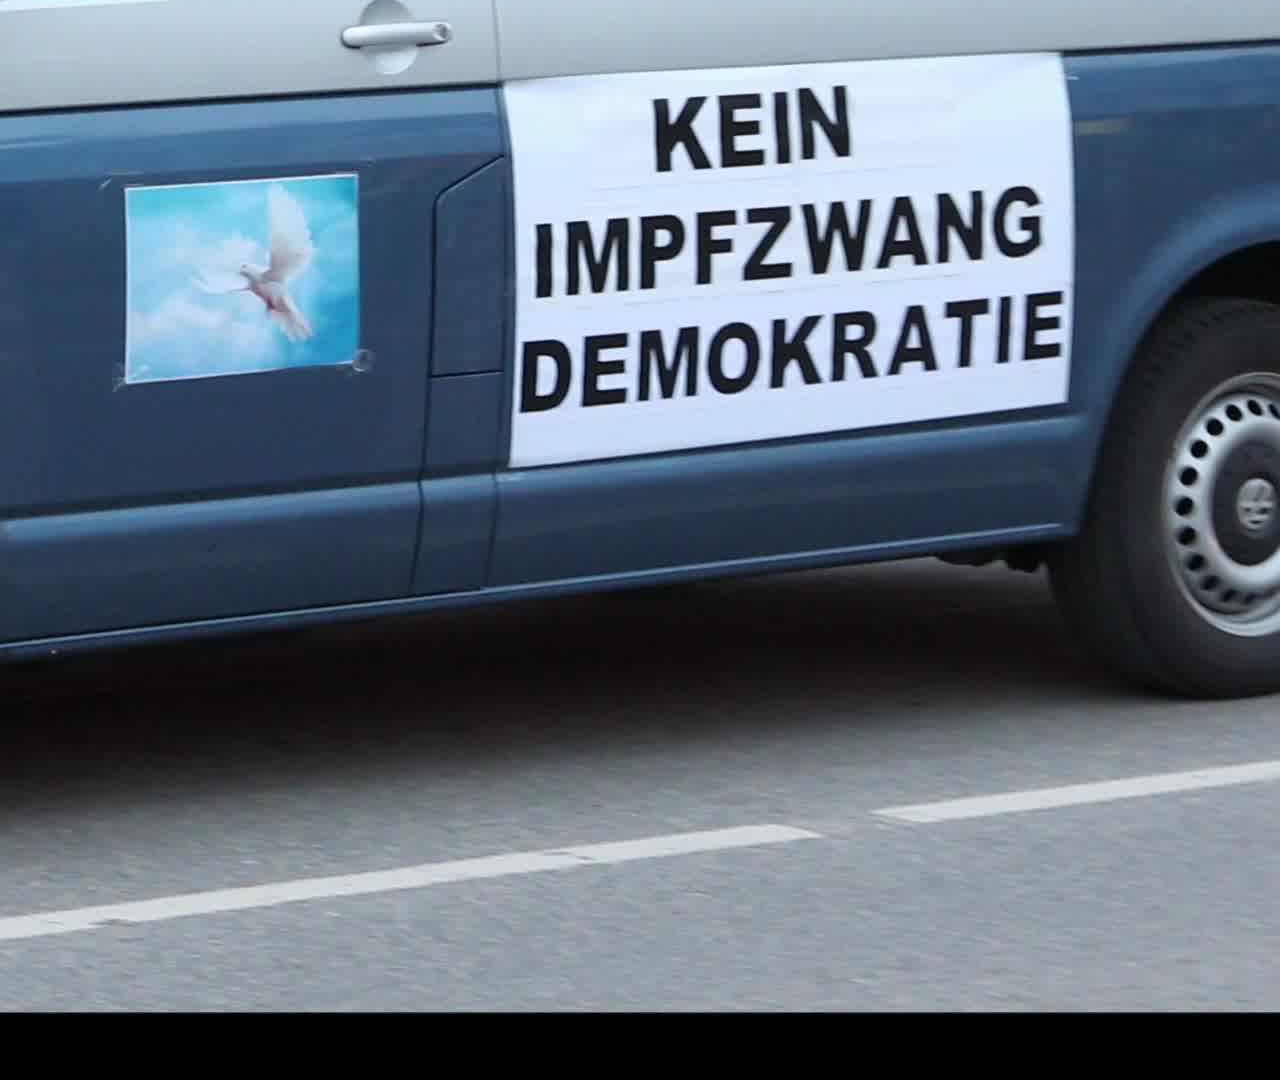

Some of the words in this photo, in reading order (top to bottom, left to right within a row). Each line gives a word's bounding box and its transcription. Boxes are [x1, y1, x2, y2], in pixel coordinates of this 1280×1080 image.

[652, 85, 851, 173] KEIN
[534, 185, 1043, 299] IMPFZWANG
[519, 291, 1064, 414] DEMOKRATIE
